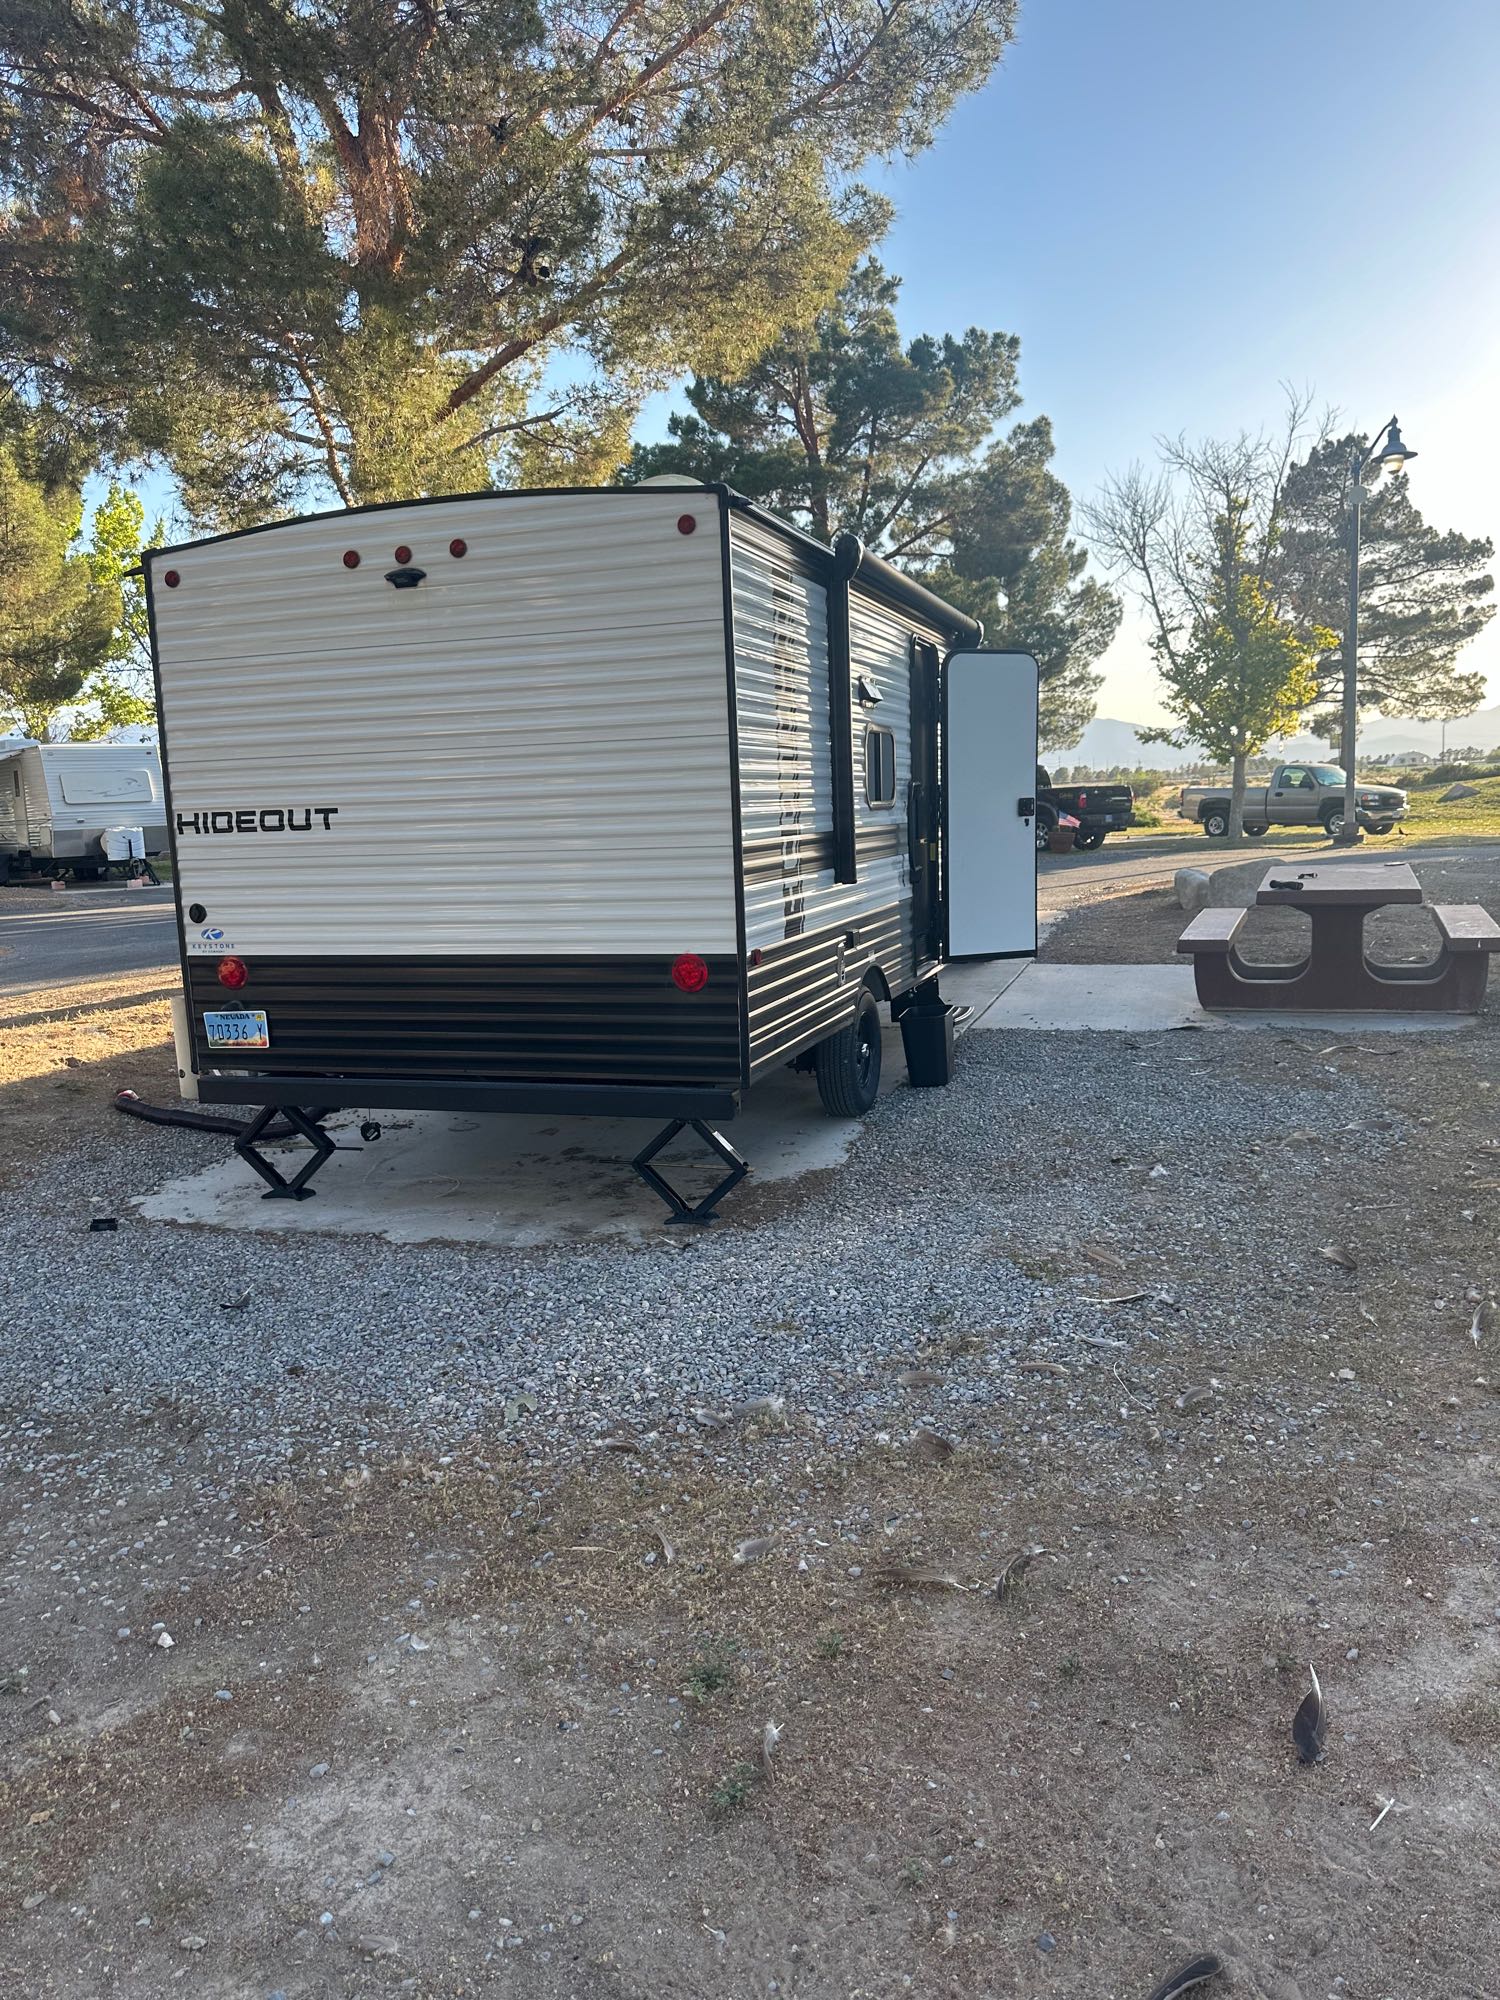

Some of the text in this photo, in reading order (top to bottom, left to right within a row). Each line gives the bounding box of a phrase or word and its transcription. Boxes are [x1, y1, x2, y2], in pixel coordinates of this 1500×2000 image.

[176, 807, 339, 835] HIDEOUT
[208, 1023, 263, 1040] 70336 Y
